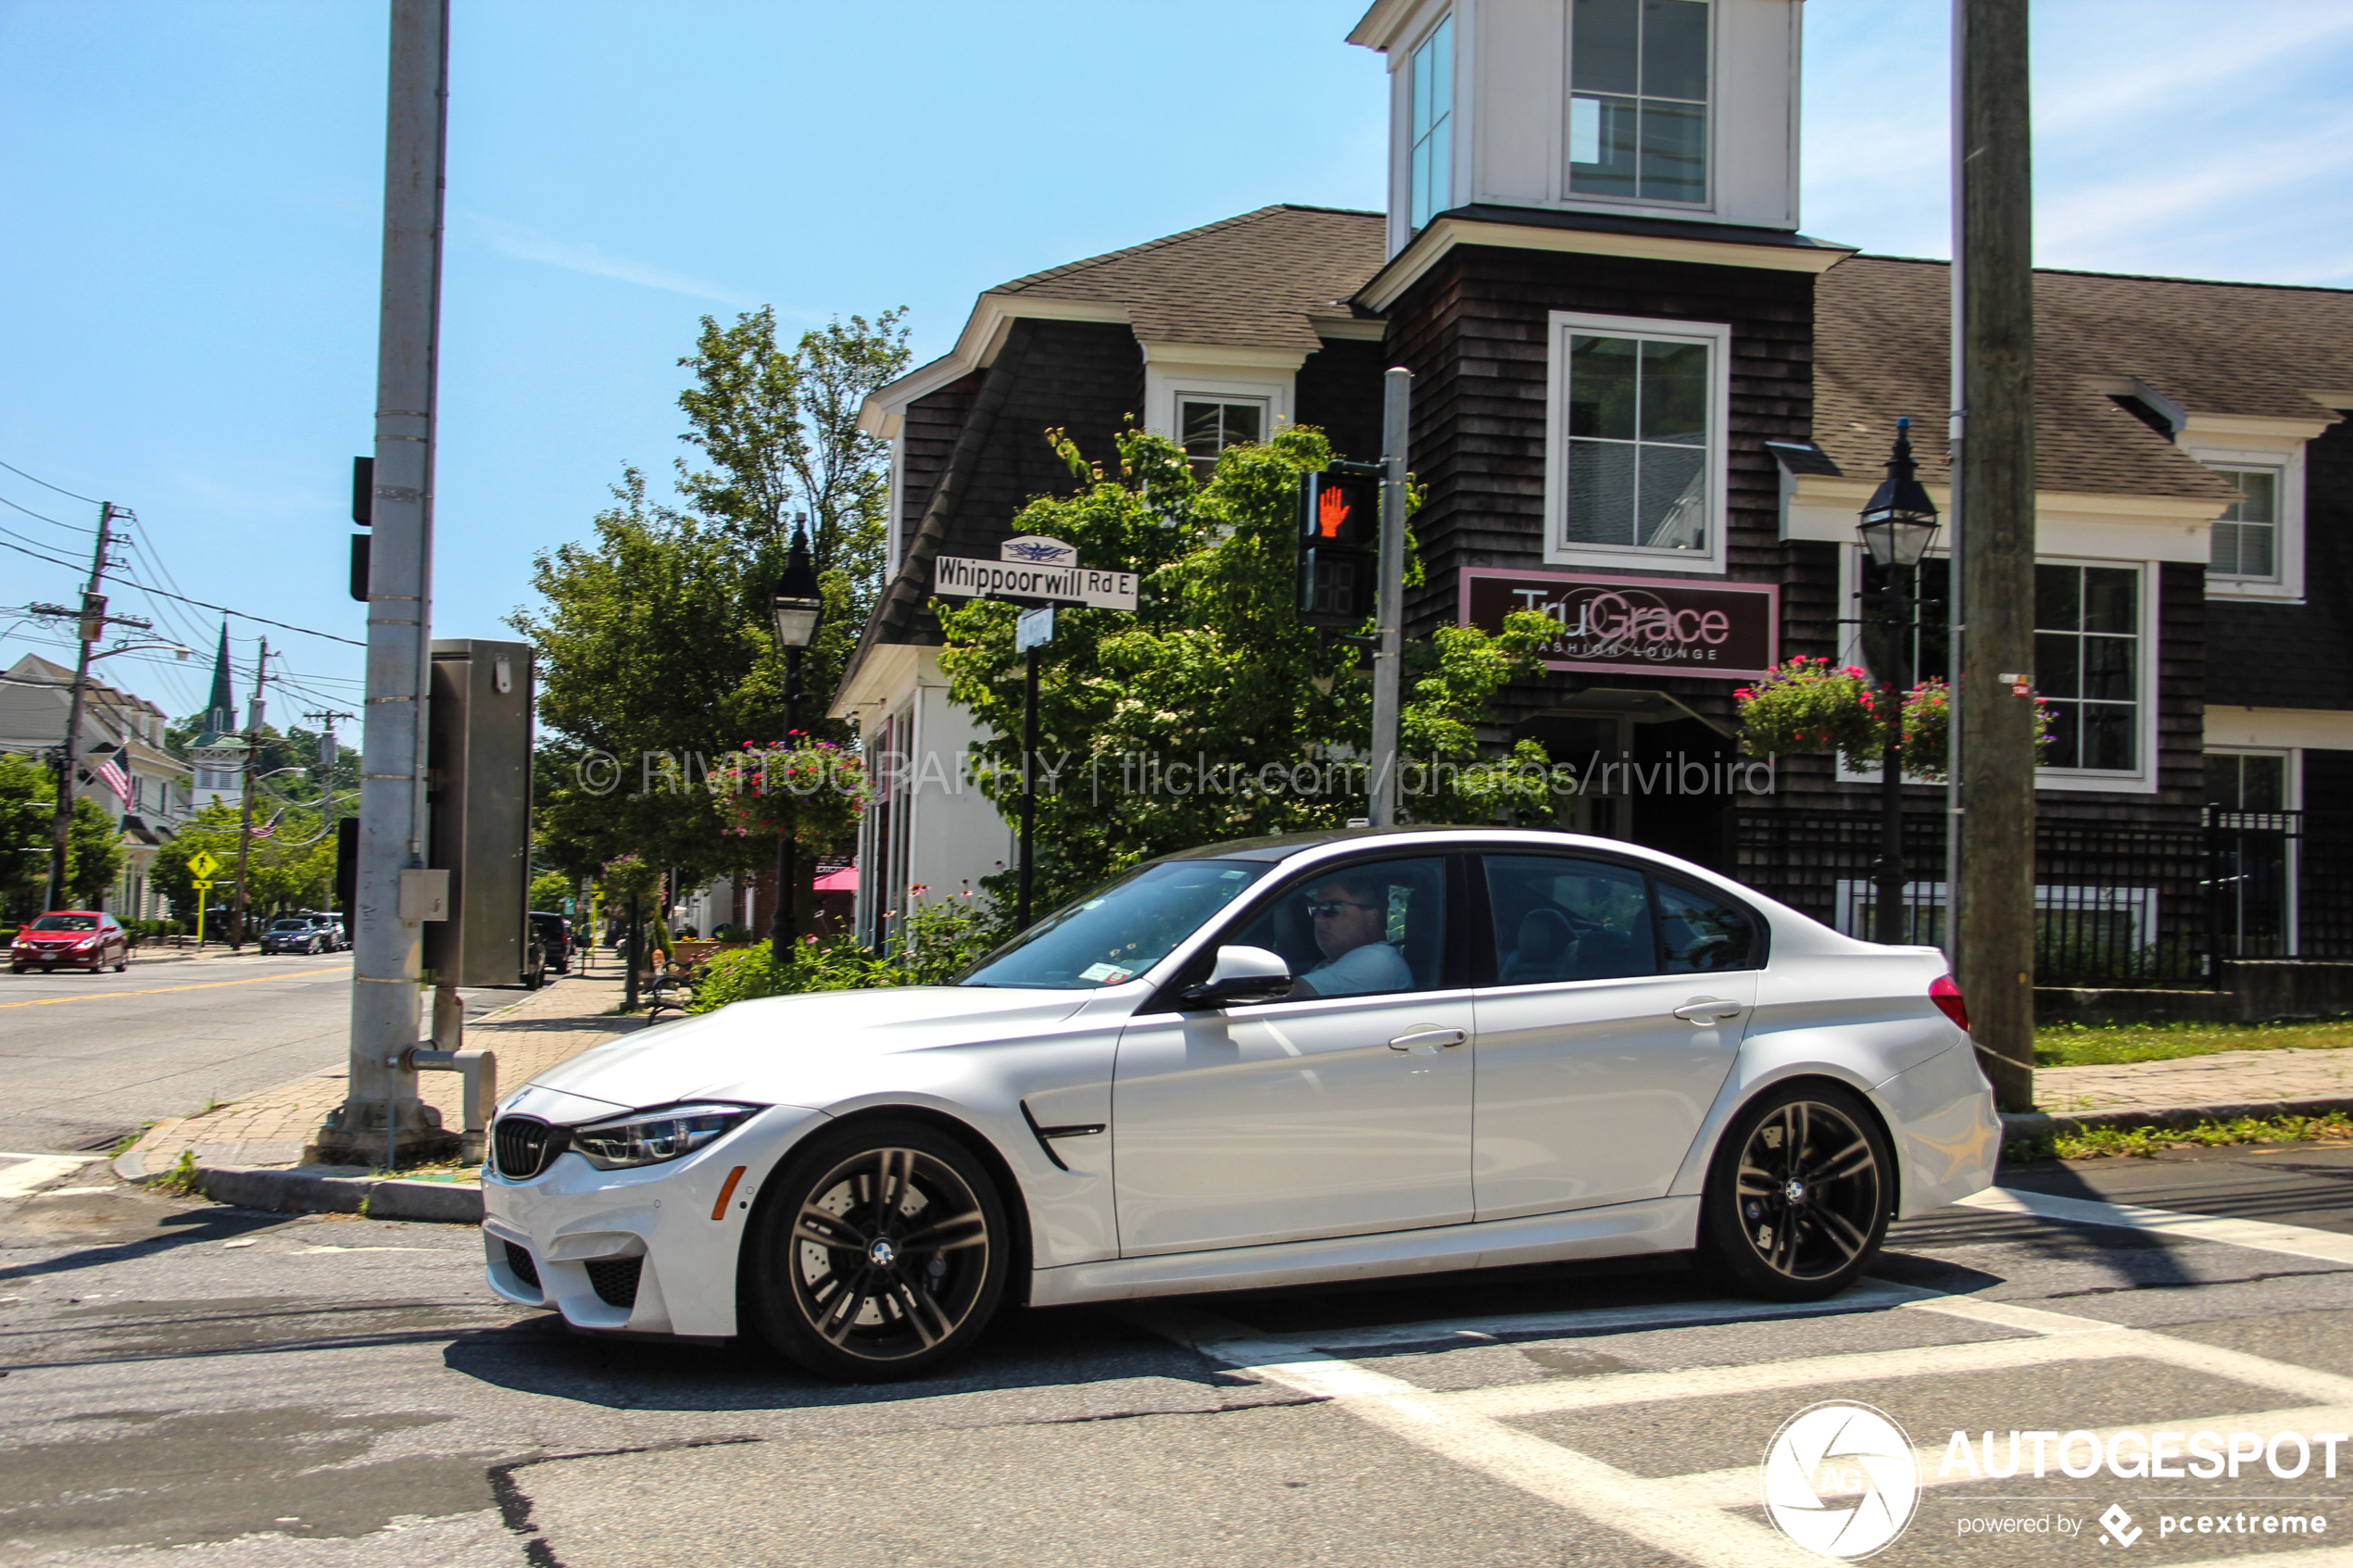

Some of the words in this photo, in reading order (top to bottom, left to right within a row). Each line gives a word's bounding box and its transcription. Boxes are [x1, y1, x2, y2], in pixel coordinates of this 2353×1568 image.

[939, 557, 1081, 596] Whippoorwill
[1088, 571, 1113, 593] Rd
[1119, 574, 1135, 595] E.
[1526, 640, 1618, 656] ASHION
[1633, 646, 1718, 660] LOUNGE
